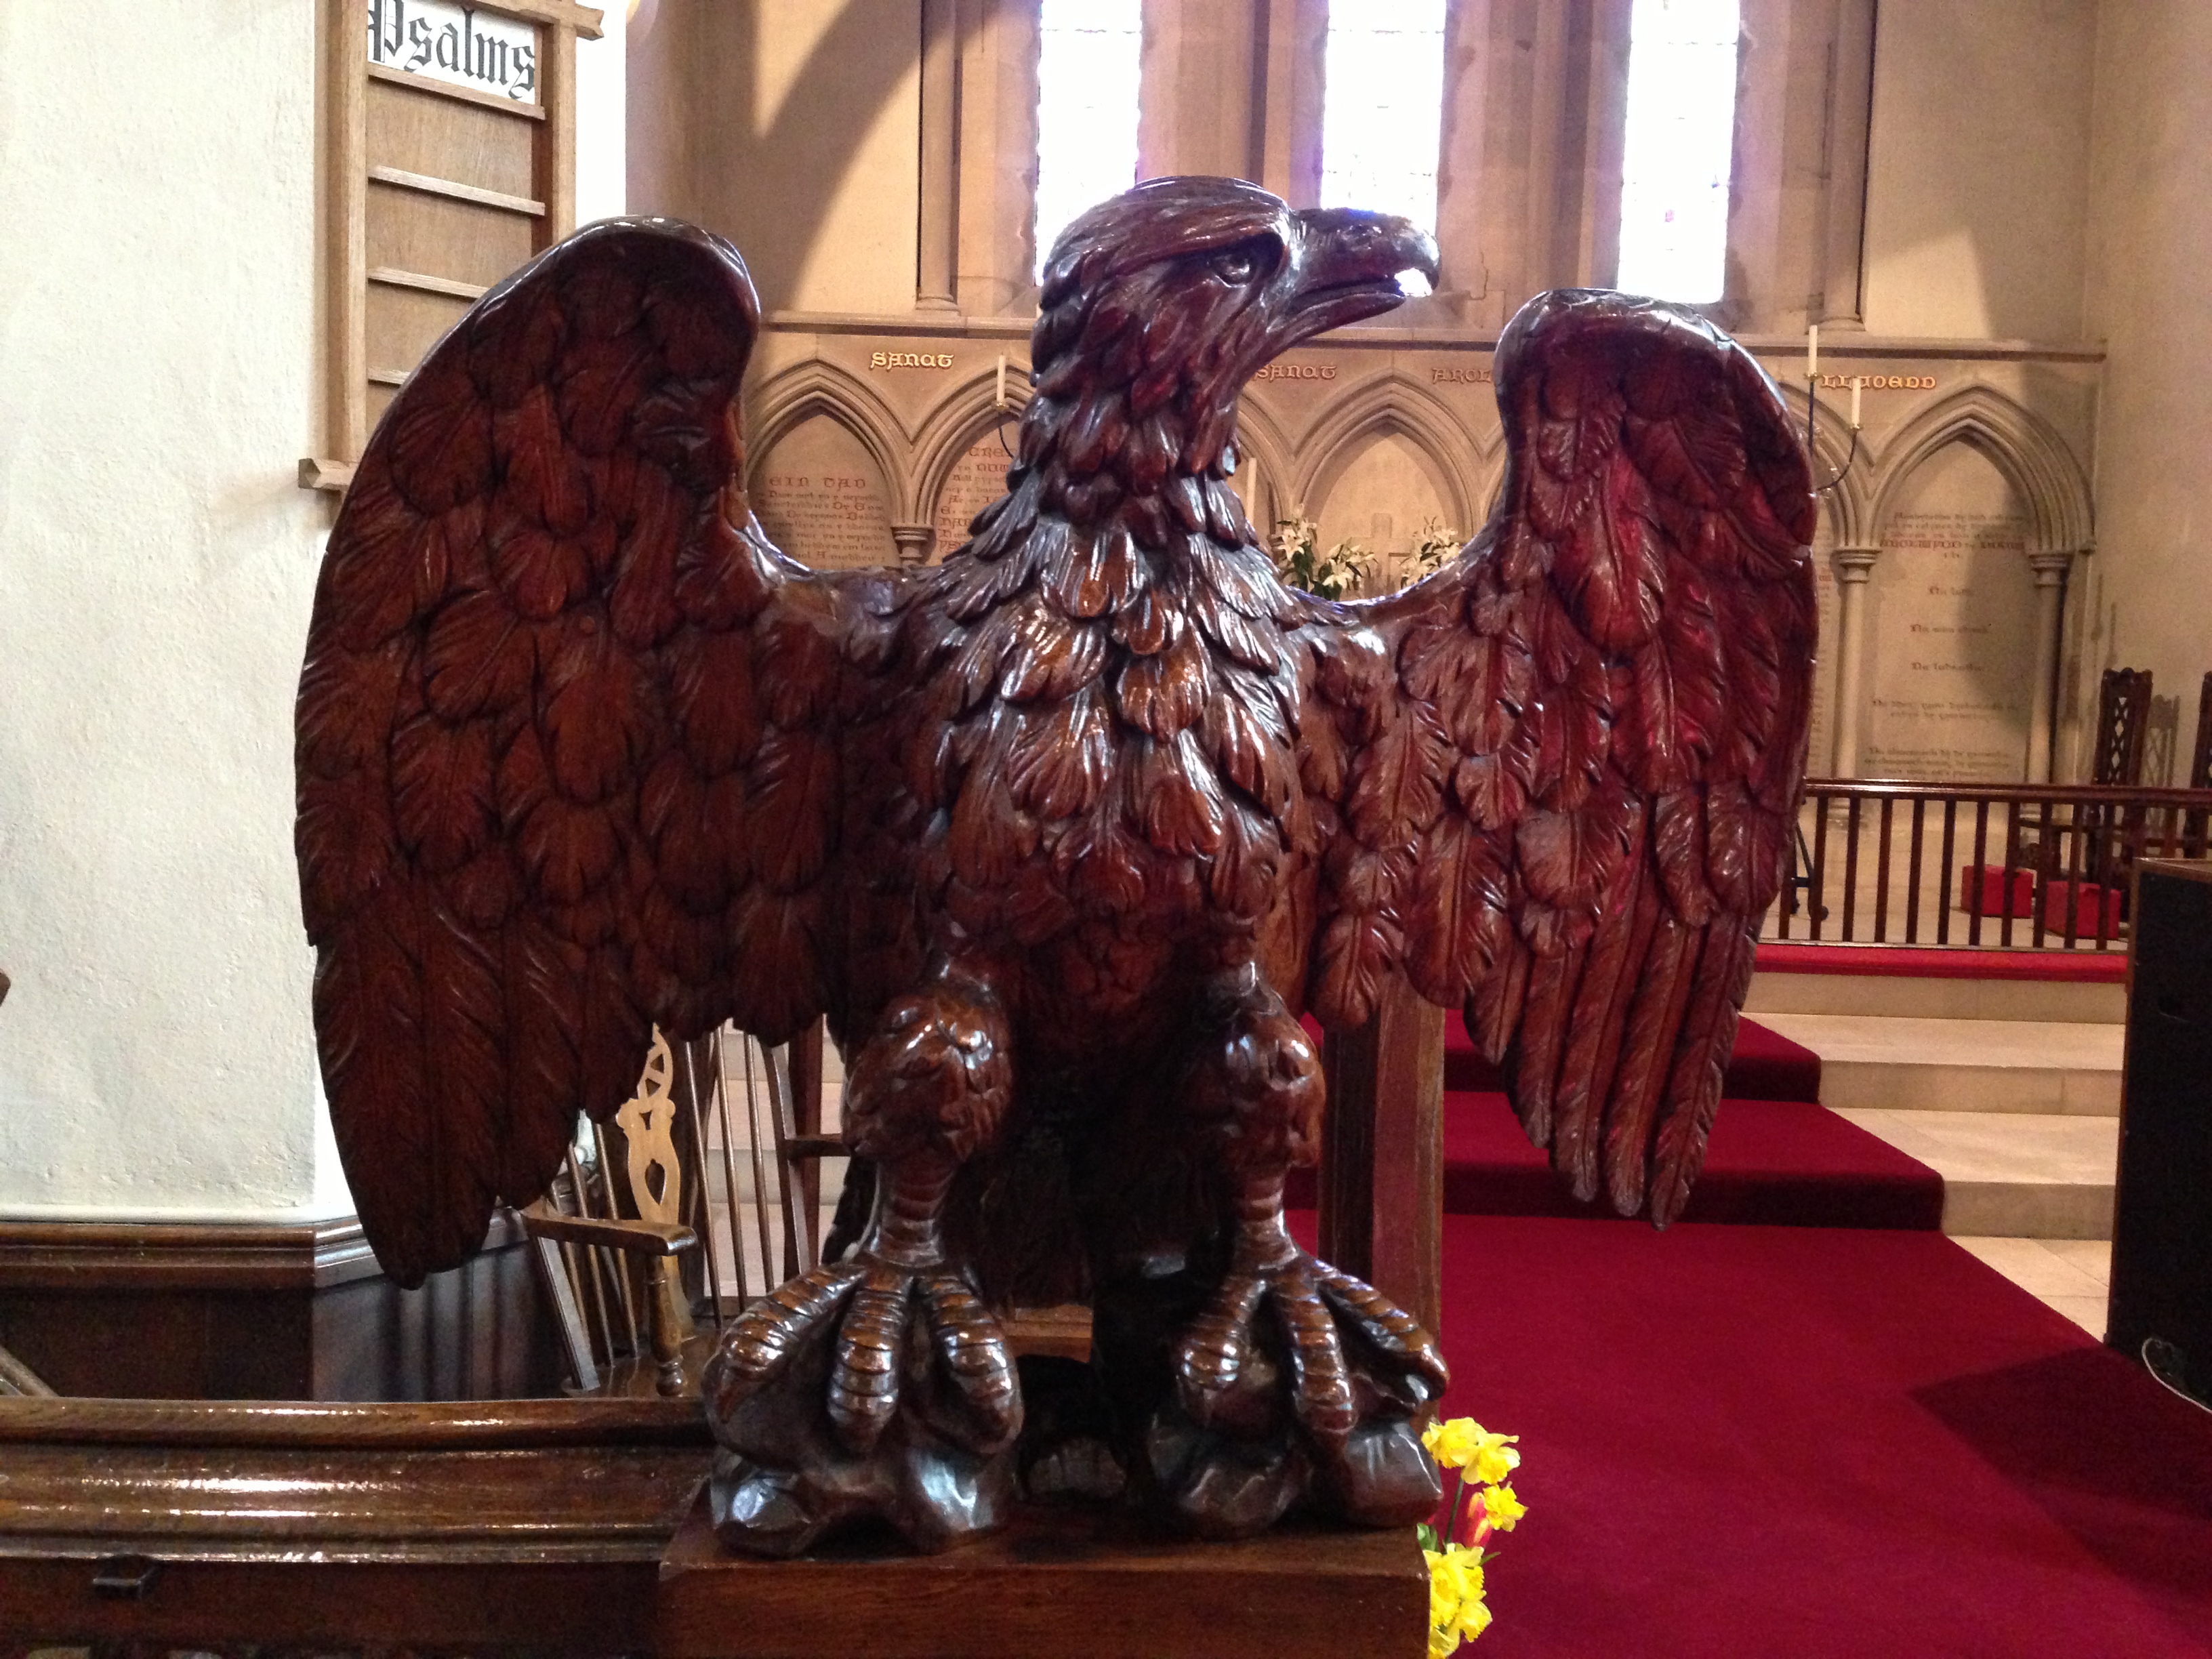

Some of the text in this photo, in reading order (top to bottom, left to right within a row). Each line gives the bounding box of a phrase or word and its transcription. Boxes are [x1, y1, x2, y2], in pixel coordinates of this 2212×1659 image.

[368, 0, 535, 100] Psalms
[769, 476, 865, 491] EIN TAD
